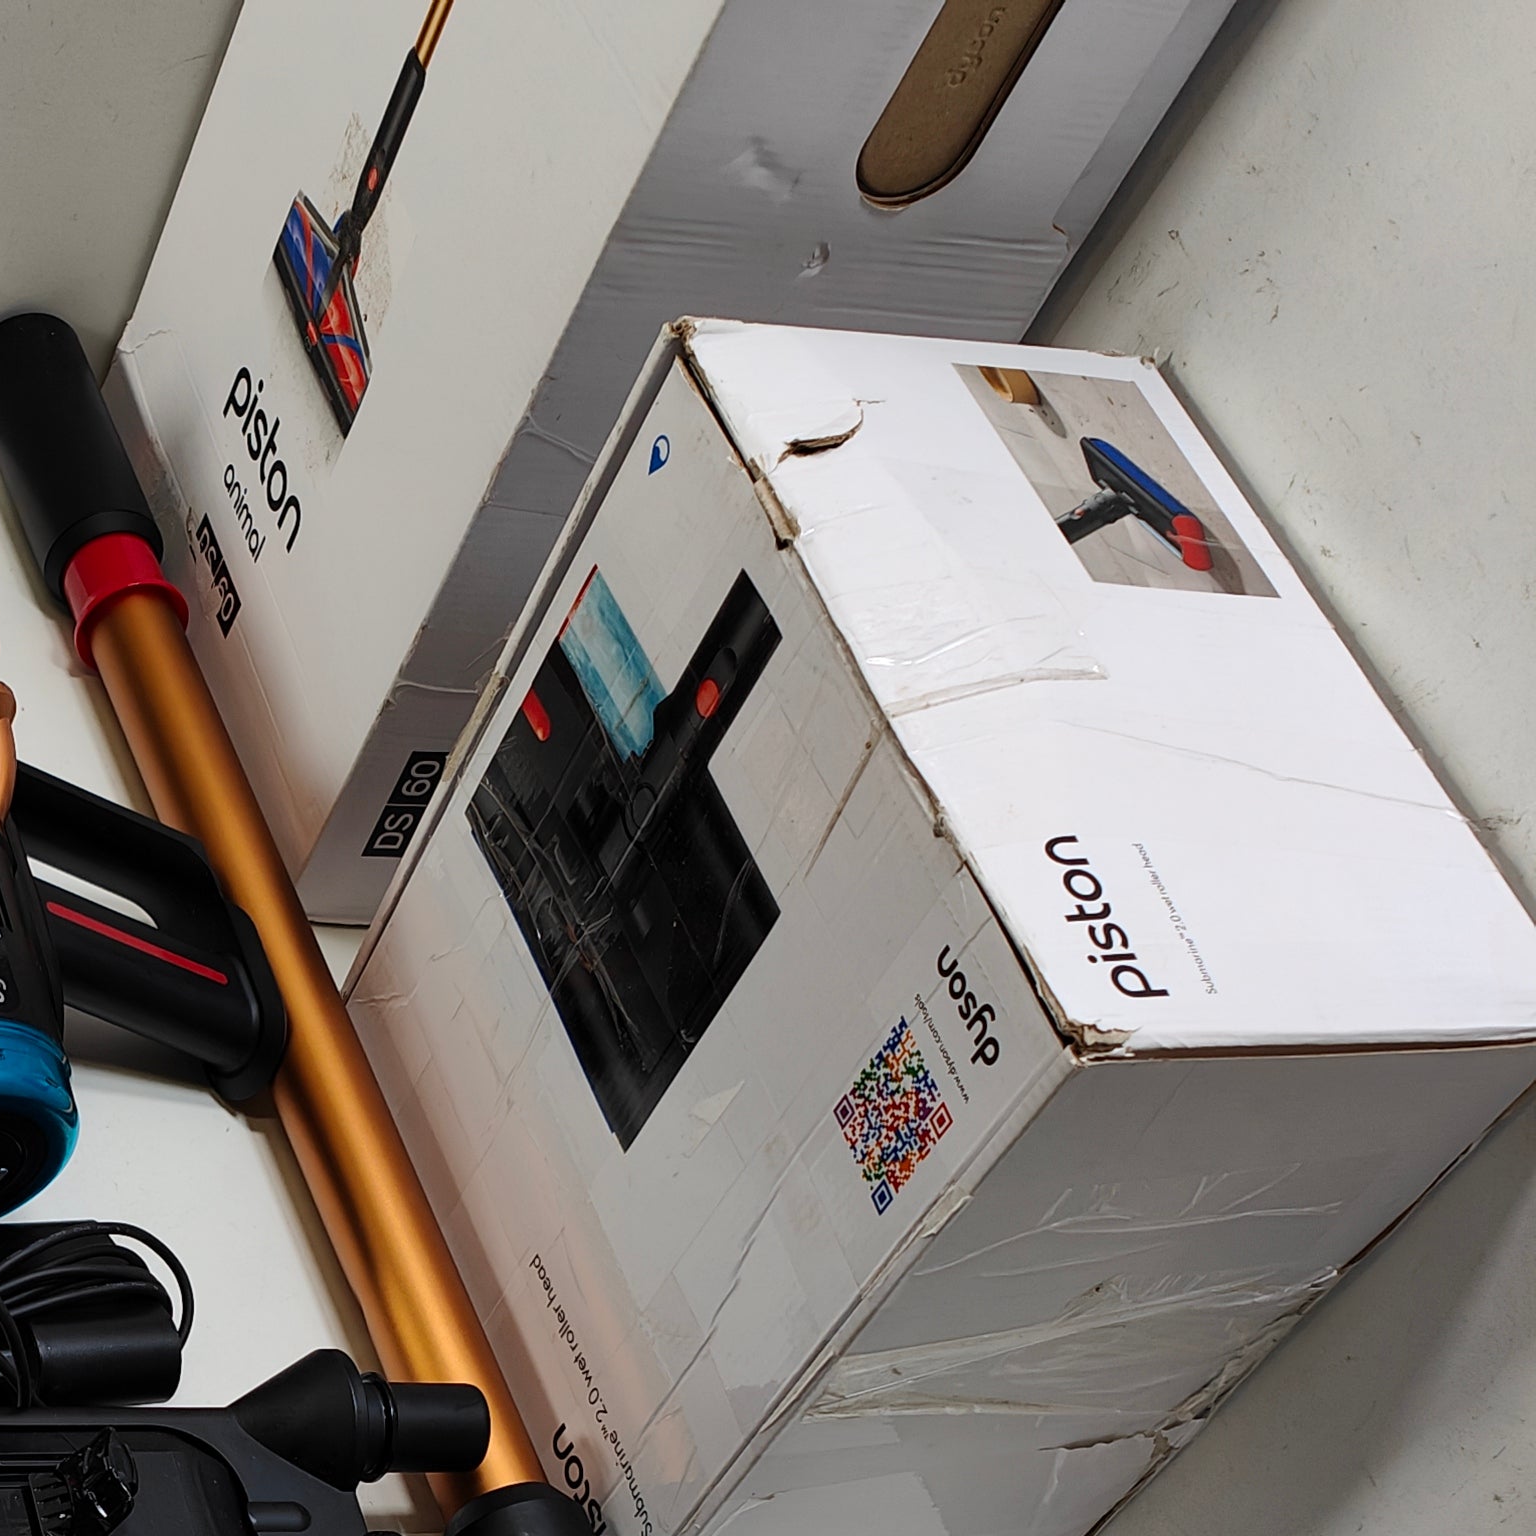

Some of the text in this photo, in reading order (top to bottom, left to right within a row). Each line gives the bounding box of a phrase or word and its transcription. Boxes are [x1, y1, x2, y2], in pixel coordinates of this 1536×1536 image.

[222, 366, 302, 554] piston
[223, 464, 266, 564] animal
[1131, 842, 1153, 869] head
[1149, 870, 1168, 896] roller
[1161, 895, 1177, 915] wet
[1044, 835, 1170, 999] piston
[1168, 914, 1187, 933] 2.0
[936, 944, 1000, 1067] dyson
[914, 993, 970, 1104] www.dyson.com/tools
[528, 1253, 557, 1308] head
[552, 1304, 579, 1352] roller
[573, 1351, 593, 1388] wet
[588, 1387, 608, 1422] 2.0
